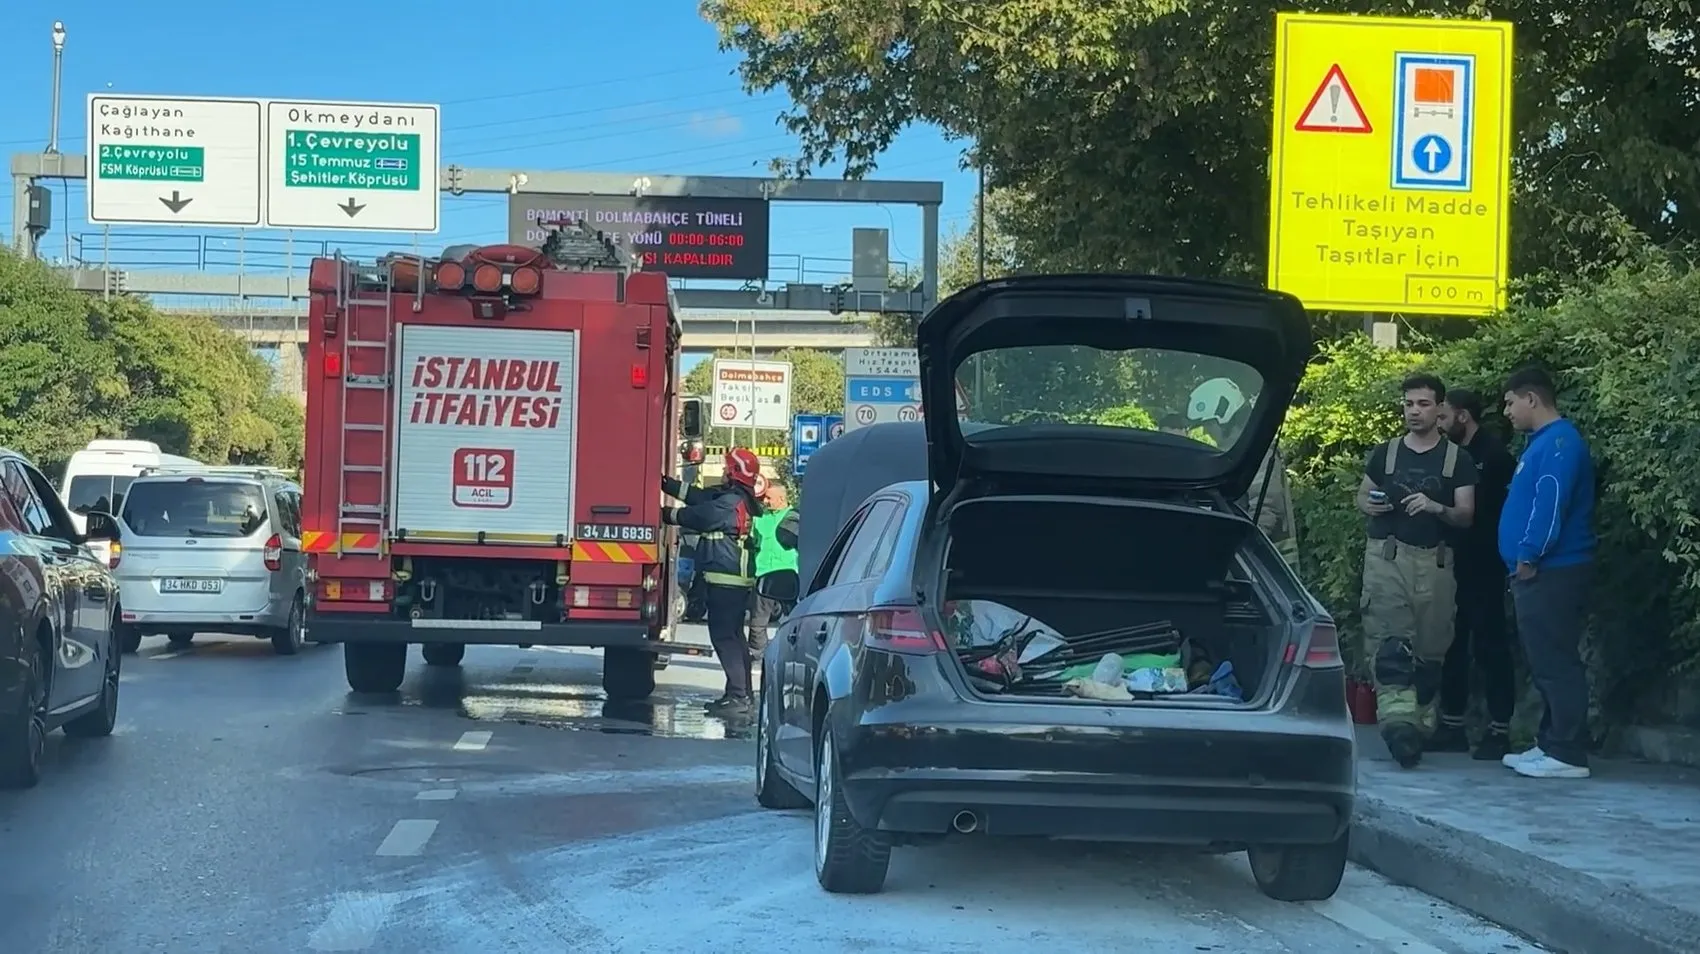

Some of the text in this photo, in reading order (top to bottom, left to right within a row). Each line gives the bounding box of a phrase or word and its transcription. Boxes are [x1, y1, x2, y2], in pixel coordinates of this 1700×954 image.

[100, 104, 183, 120] Çağlayan
[288, 108, 414, 128] Okmeydanı
[101, 123, 195, 138] Kağıthane
[288, 132, 408, 153] 1. Çevreyolu
[291, 154, 371, 168] 15 Temmuz
[101, 163, 168, 178] FSM Köprüsü
[291, 171, 408, 188] Şehitler Köprüsü
[1291, 191, 1487, 216] Tehlikeli Madde
[595, 211, 689, 226] DOLMABAHÇE
[696, 211, 743, 226] TÜNELİ
[627, 230, 662, 245] YÖNÜ
[1343, 219, 1434, 242] Taşıyan
[664, 253, 733, 266] KAPALIDIR
[1316, 244, 1459, 269] Taşıtlar İçin
[1417, 286, 1483, 301] 100 m
[863, 349, 917, 357] Ortalama
[861, 386, 892, 397] EDS
[860, 409, 873, 421] 70
[902, 410, 915, 421] 70
[464, 453, 506, 482] 112
[583, 525, 599, 538] 34
[603, 526, 618, 539] AJ
[167, 580, 178, 589] 34
[201, 581, 219, 590] 053
